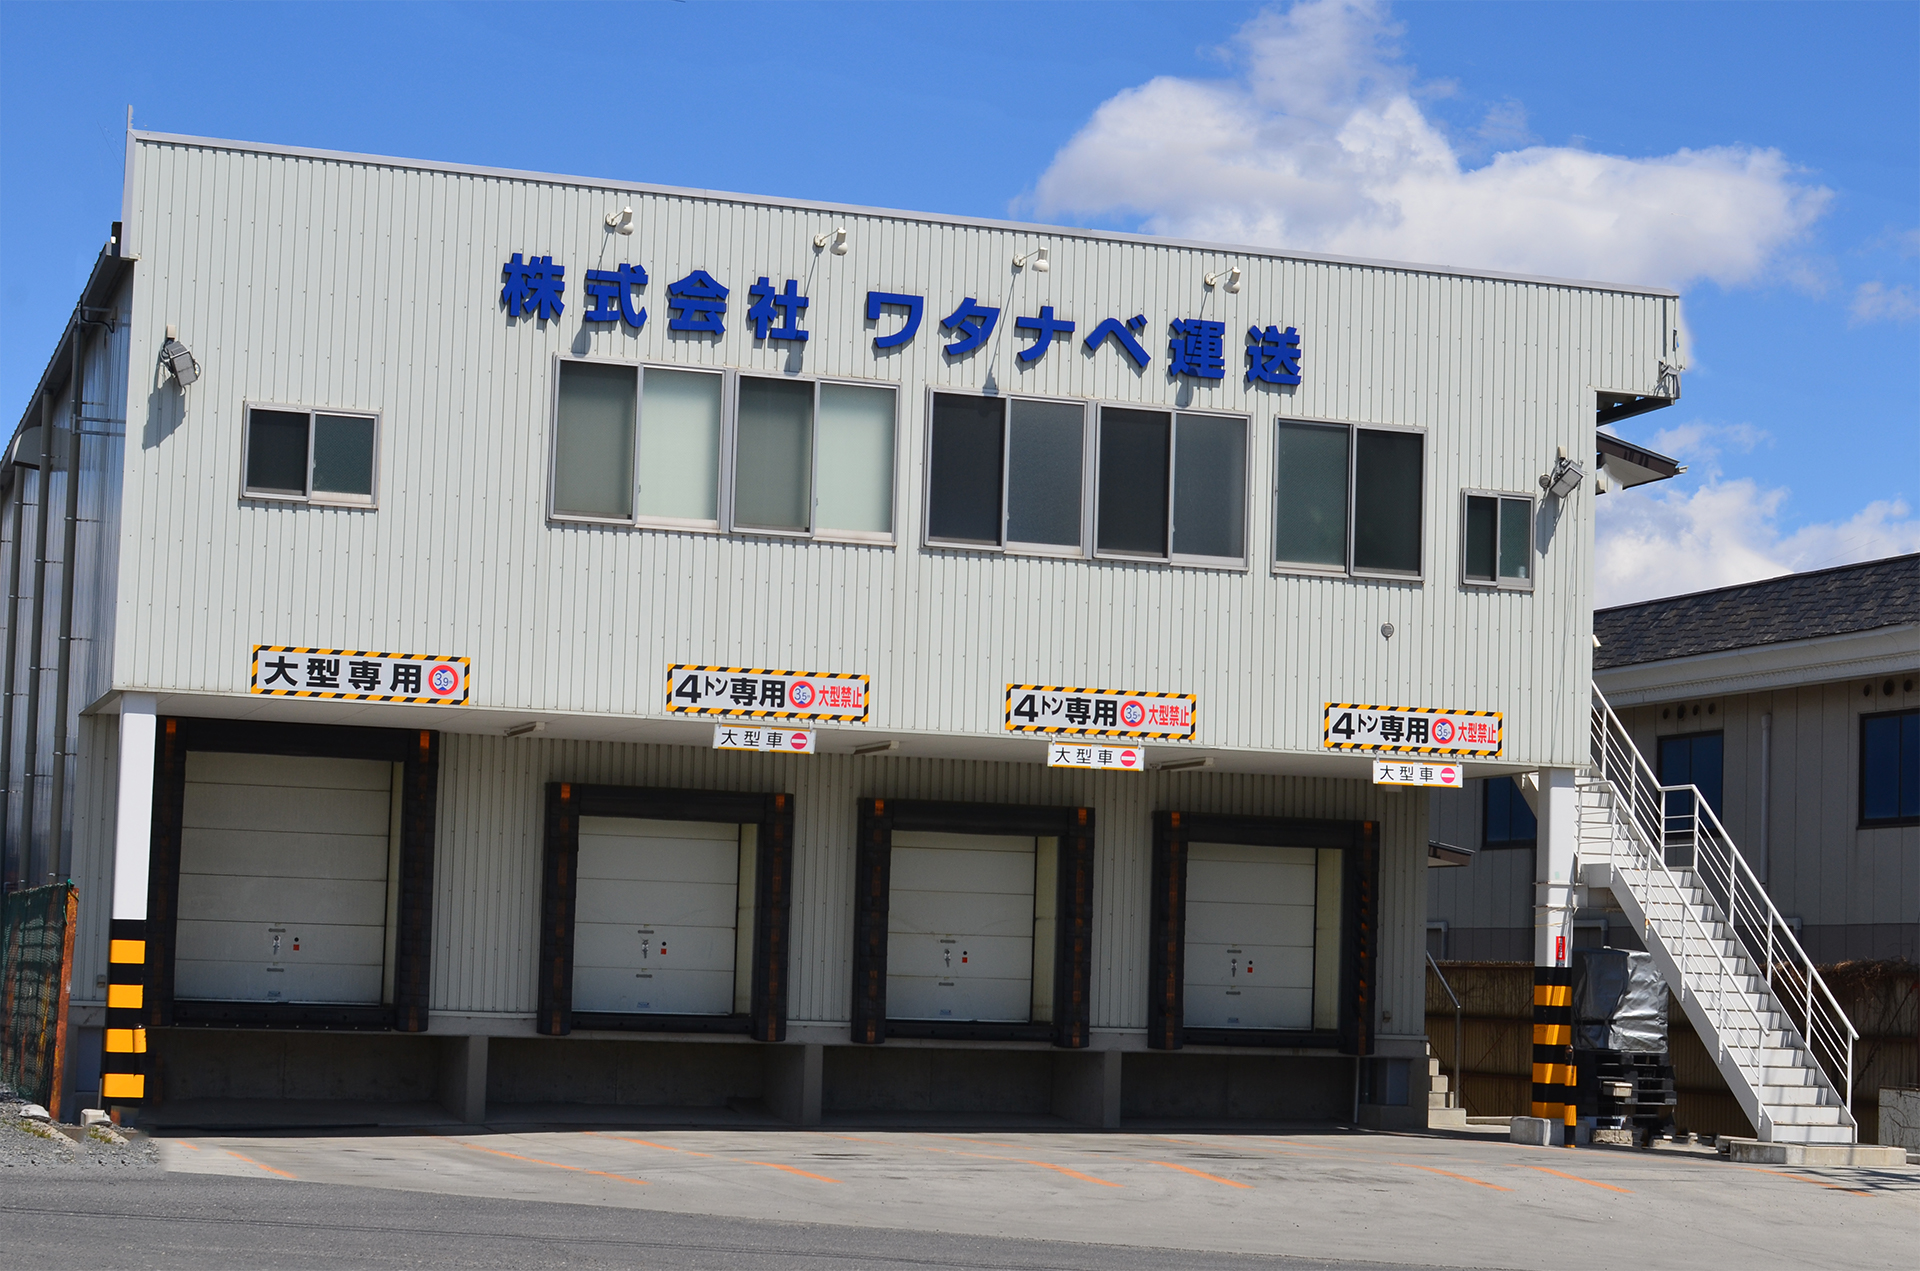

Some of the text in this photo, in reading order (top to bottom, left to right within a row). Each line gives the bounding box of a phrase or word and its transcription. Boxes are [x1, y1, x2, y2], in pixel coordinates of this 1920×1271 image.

[501, 252, 1304, 385] 株式会社 ワタナベ運送
[264, 655, 422, 694] 大型専用
[675, 674, 786, 708] 4トン専用
[818, 685, 862, 708] 大型禁止
[1014, 694, 1118, 727] 4トン専用
[1148, 704, 1190, 727] 大型禁止
[721, 729, 783, 748] 大型車
[1331, 712, 1429, 744] 4トン専用
[1457, 721, 1497, 745] 大型禁止
[1055, 747, 1113, 766] 大型車
[1379, 765, 1434, 782] 大型車
